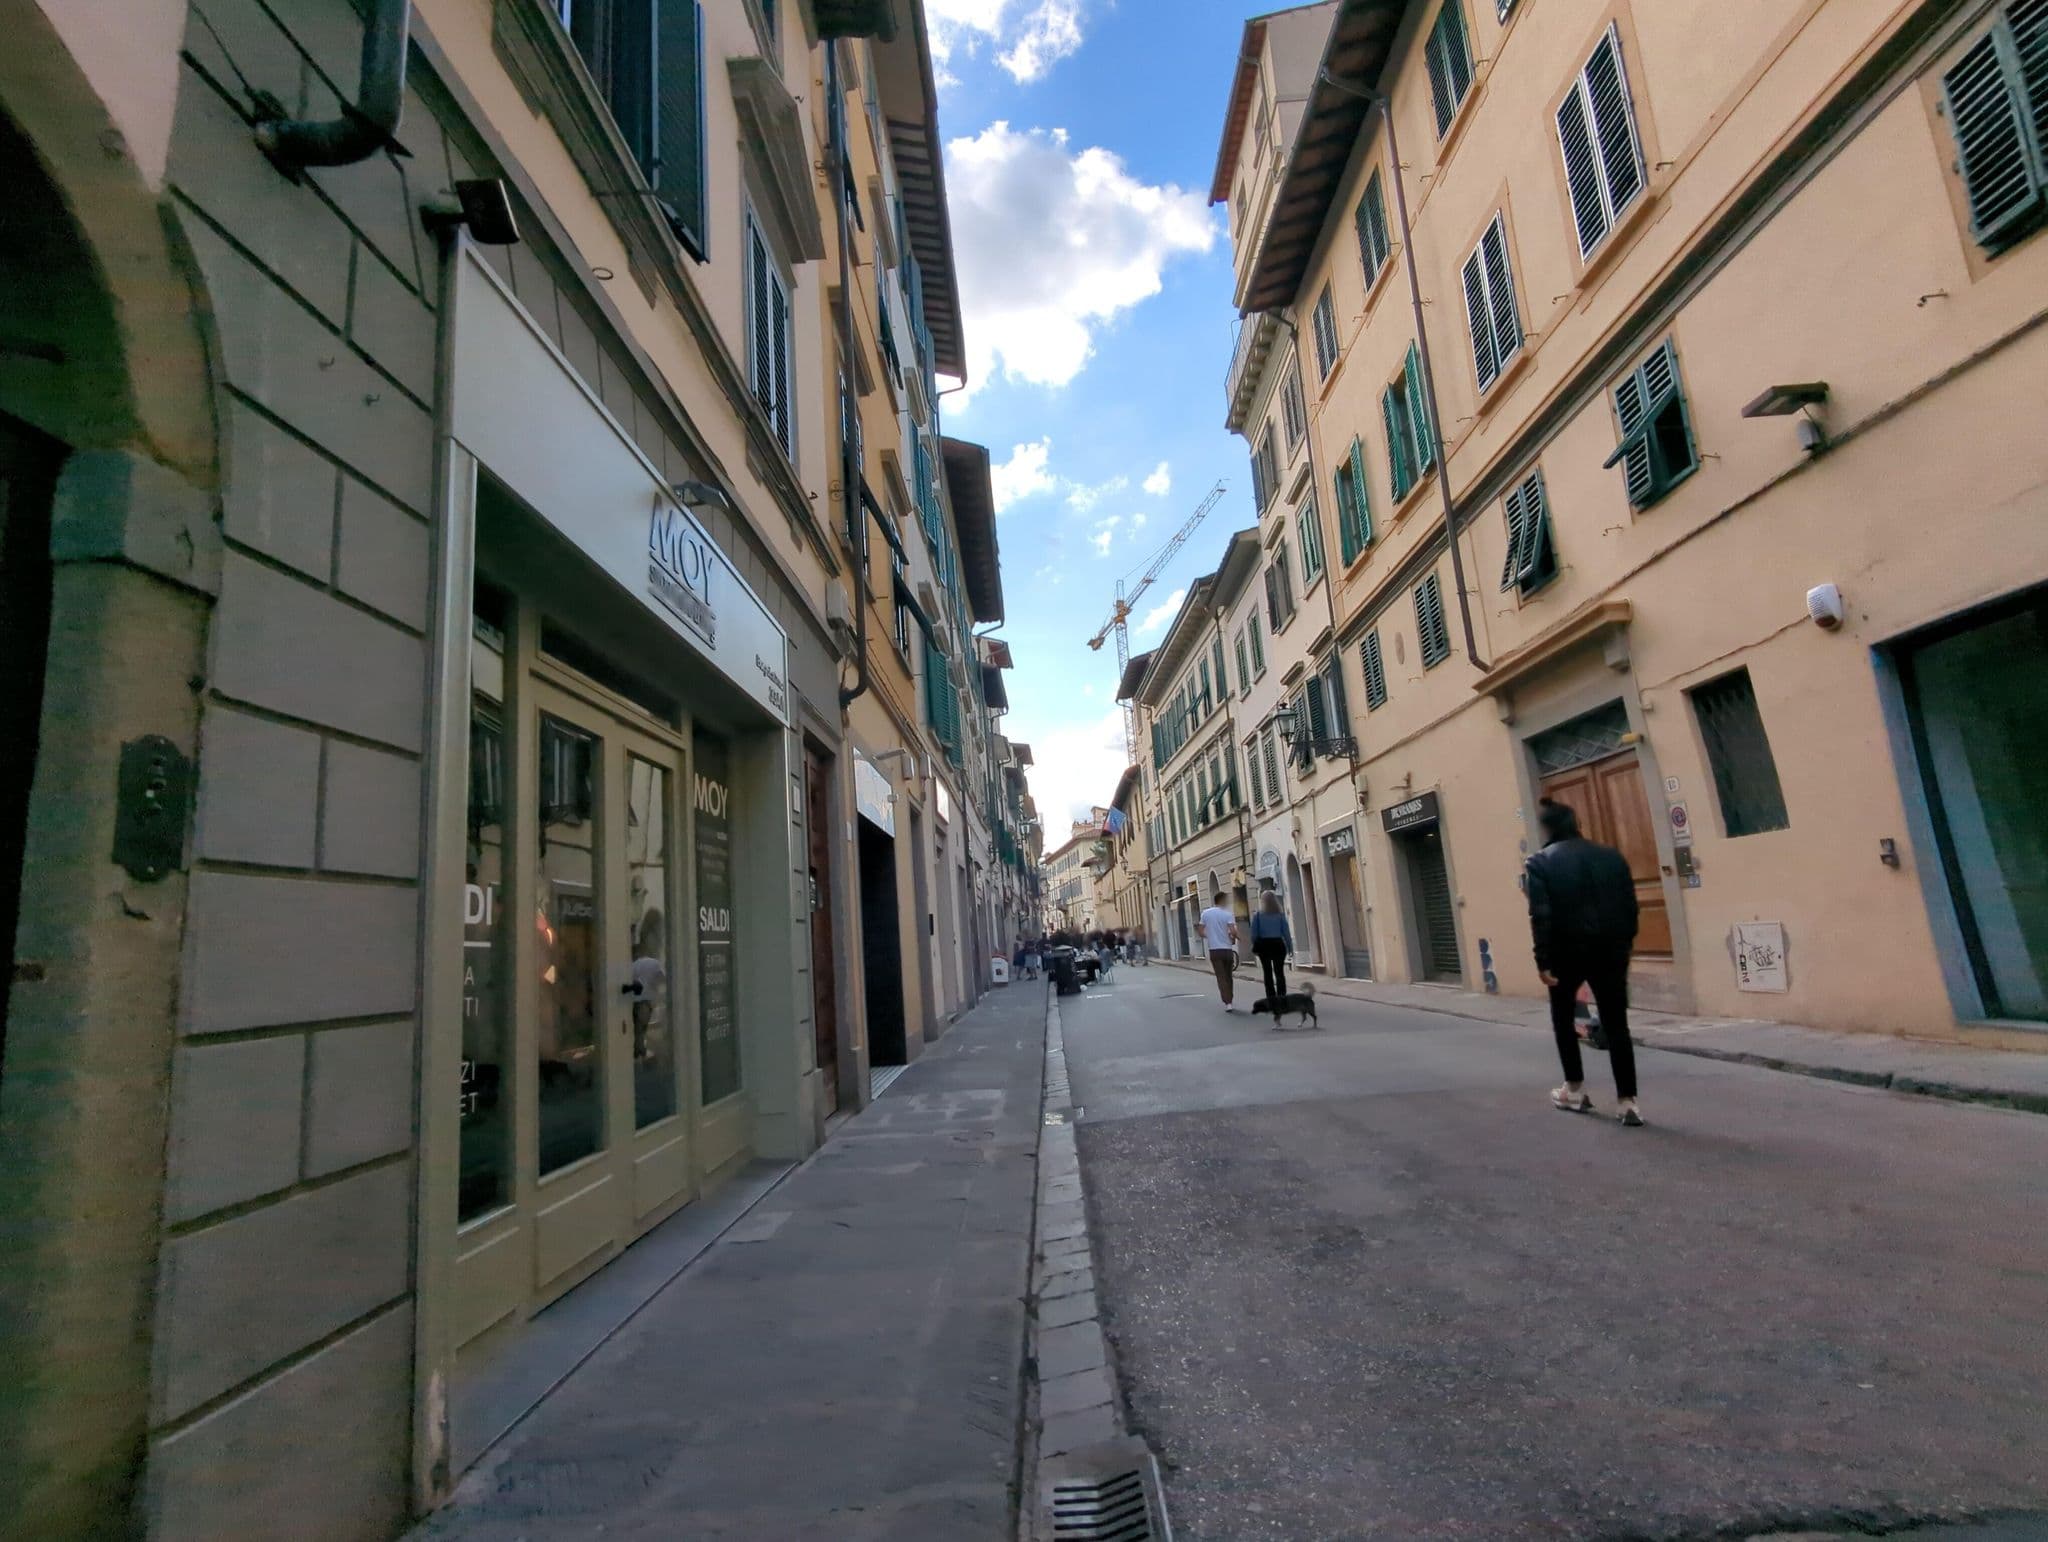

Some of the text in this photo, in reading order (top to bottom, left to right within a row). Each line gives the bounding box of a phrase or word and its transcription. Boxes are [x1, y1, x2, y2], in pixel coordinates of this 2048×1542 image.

[649, 493, 713, 606] MOY
[694, 772, 728, 820] MOY
[700, 906, 730, 933] SALDI
